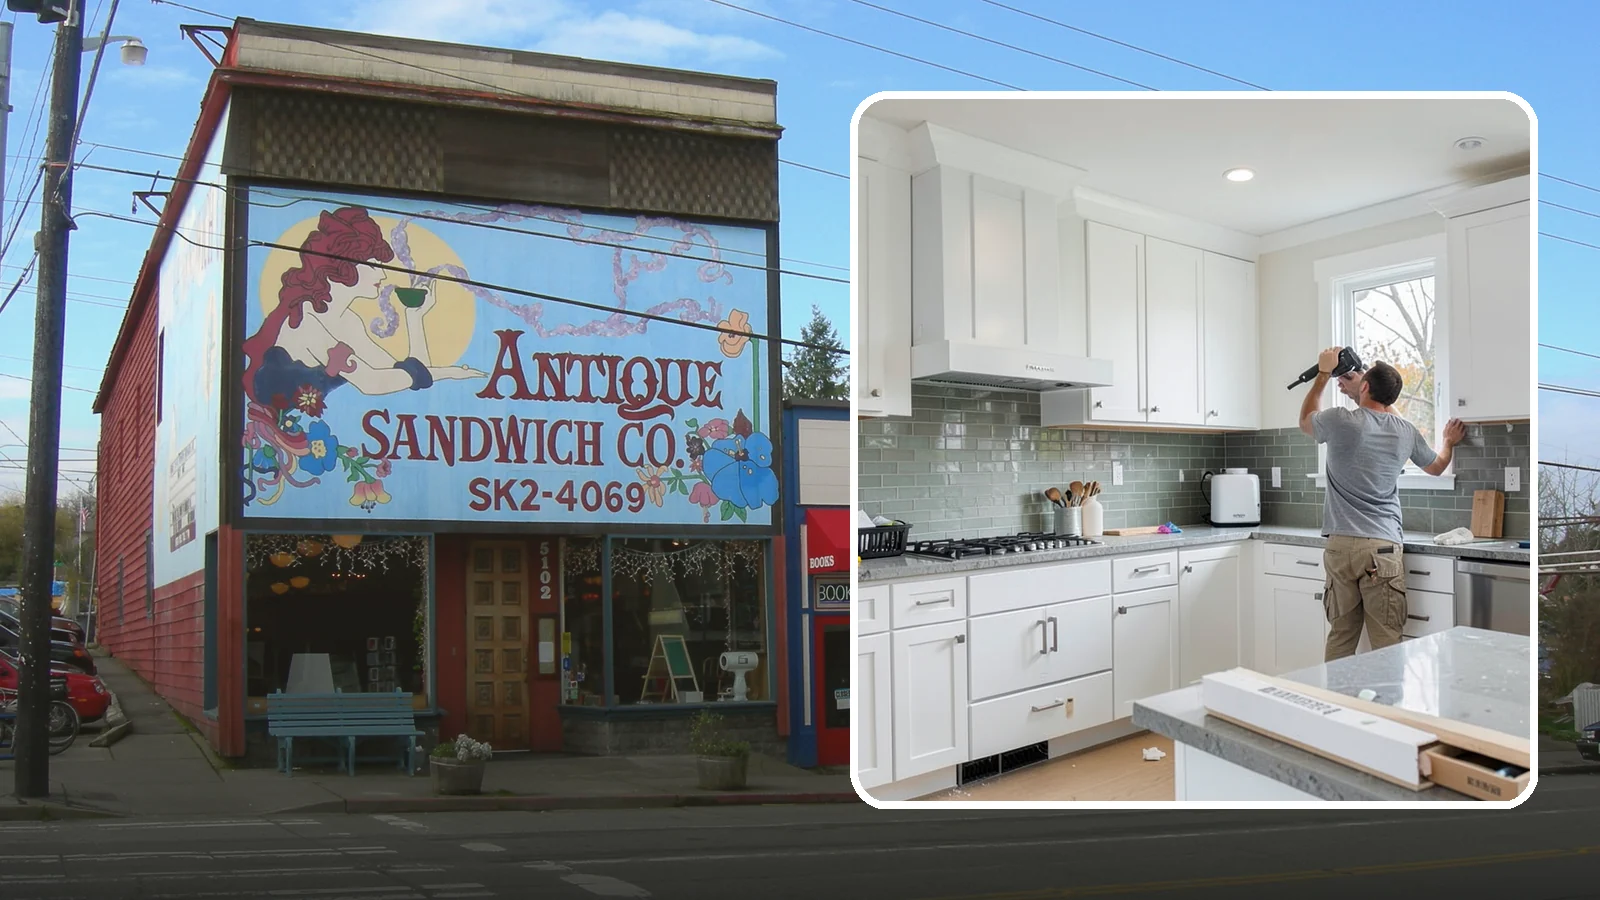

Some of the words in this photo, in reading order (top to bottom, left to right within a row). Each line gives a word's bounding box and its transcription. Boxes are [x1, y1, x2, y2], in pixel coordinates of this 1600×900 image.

[475, 329, 724, 420] ANTIQUE
[361, 408, 604, 467] SANDWICH
[617, 422, 684, 468] CO.
[468, 478, 646, 513] SK2-4069
[539, 542, 552, 600] 5102
[809, 555, 835, 569] BOOKS
